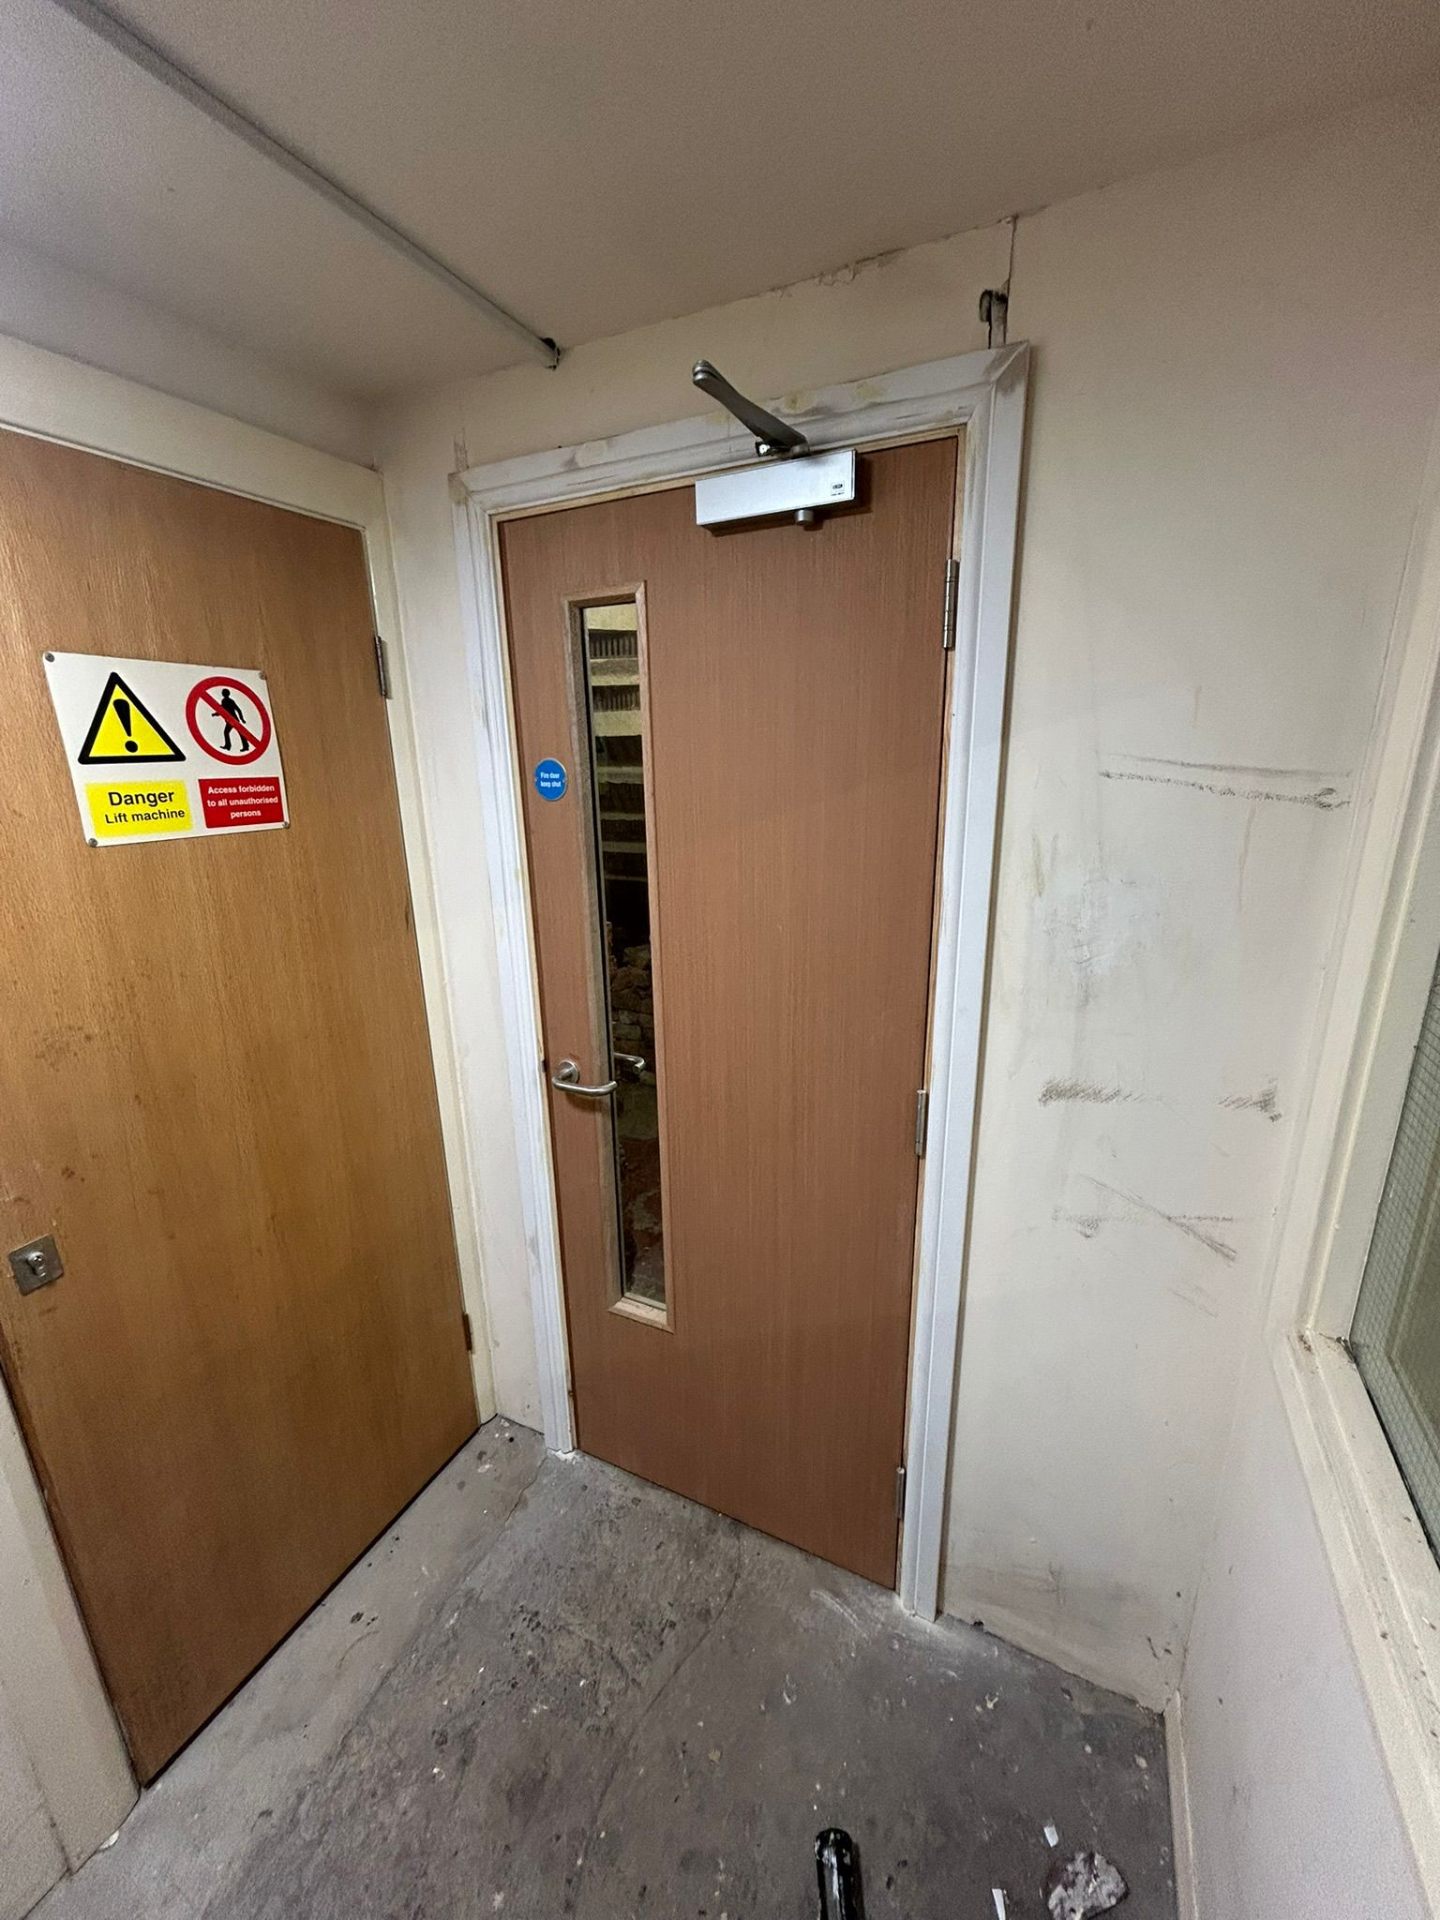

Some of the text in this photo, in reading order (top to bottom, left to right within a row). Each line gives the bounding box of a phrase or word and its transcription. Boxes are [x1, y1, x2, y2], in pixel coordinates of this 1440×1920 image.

[208, 784, 275, 794] Access forbidden
[108, 791, 175, 807] Danger
[207, 796, 279, 807] to all unauthorised
[105, 809, 185, 824] Lift machine
[230, 810, 261, 819] persons
